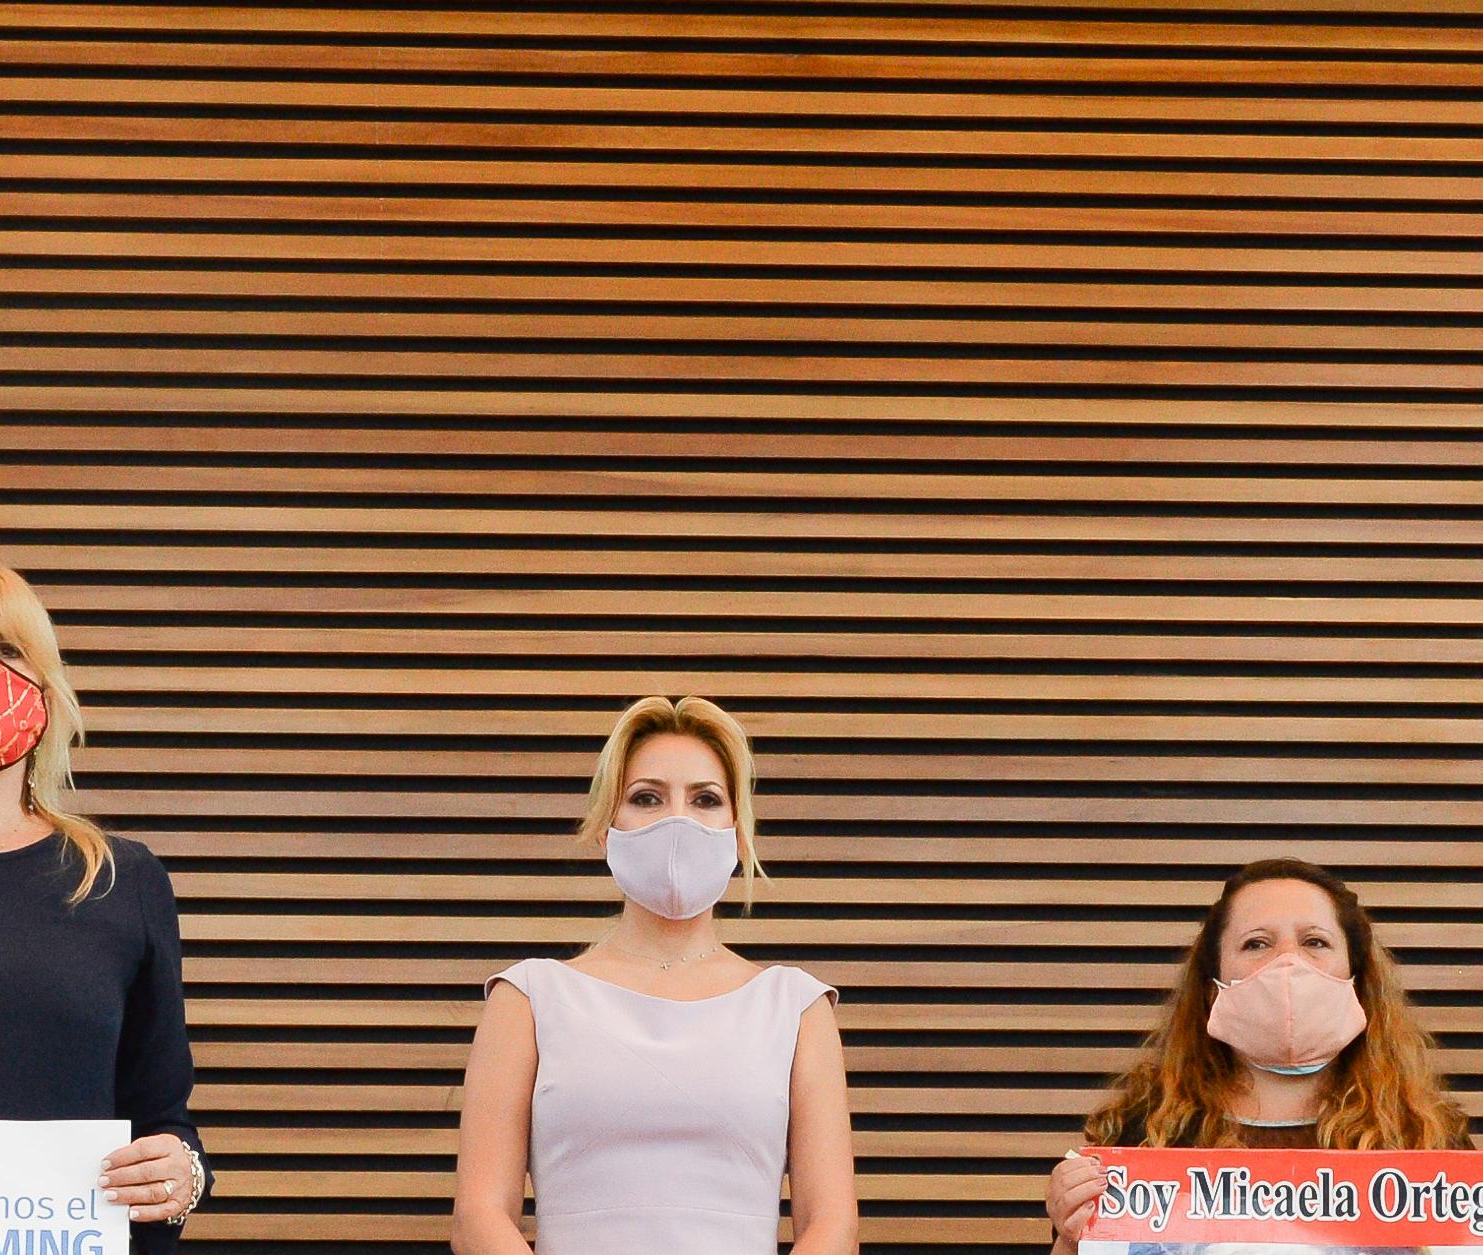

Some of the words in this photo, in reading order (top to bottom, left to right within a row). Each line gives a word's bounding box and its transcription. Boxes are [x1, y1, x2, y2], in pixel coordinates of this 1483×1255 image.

[67, 1188, 99, 1221] el
[1099, 1166, 1179, 1232] Soy
[1187, 1167, 1360, 1222] Micaela
